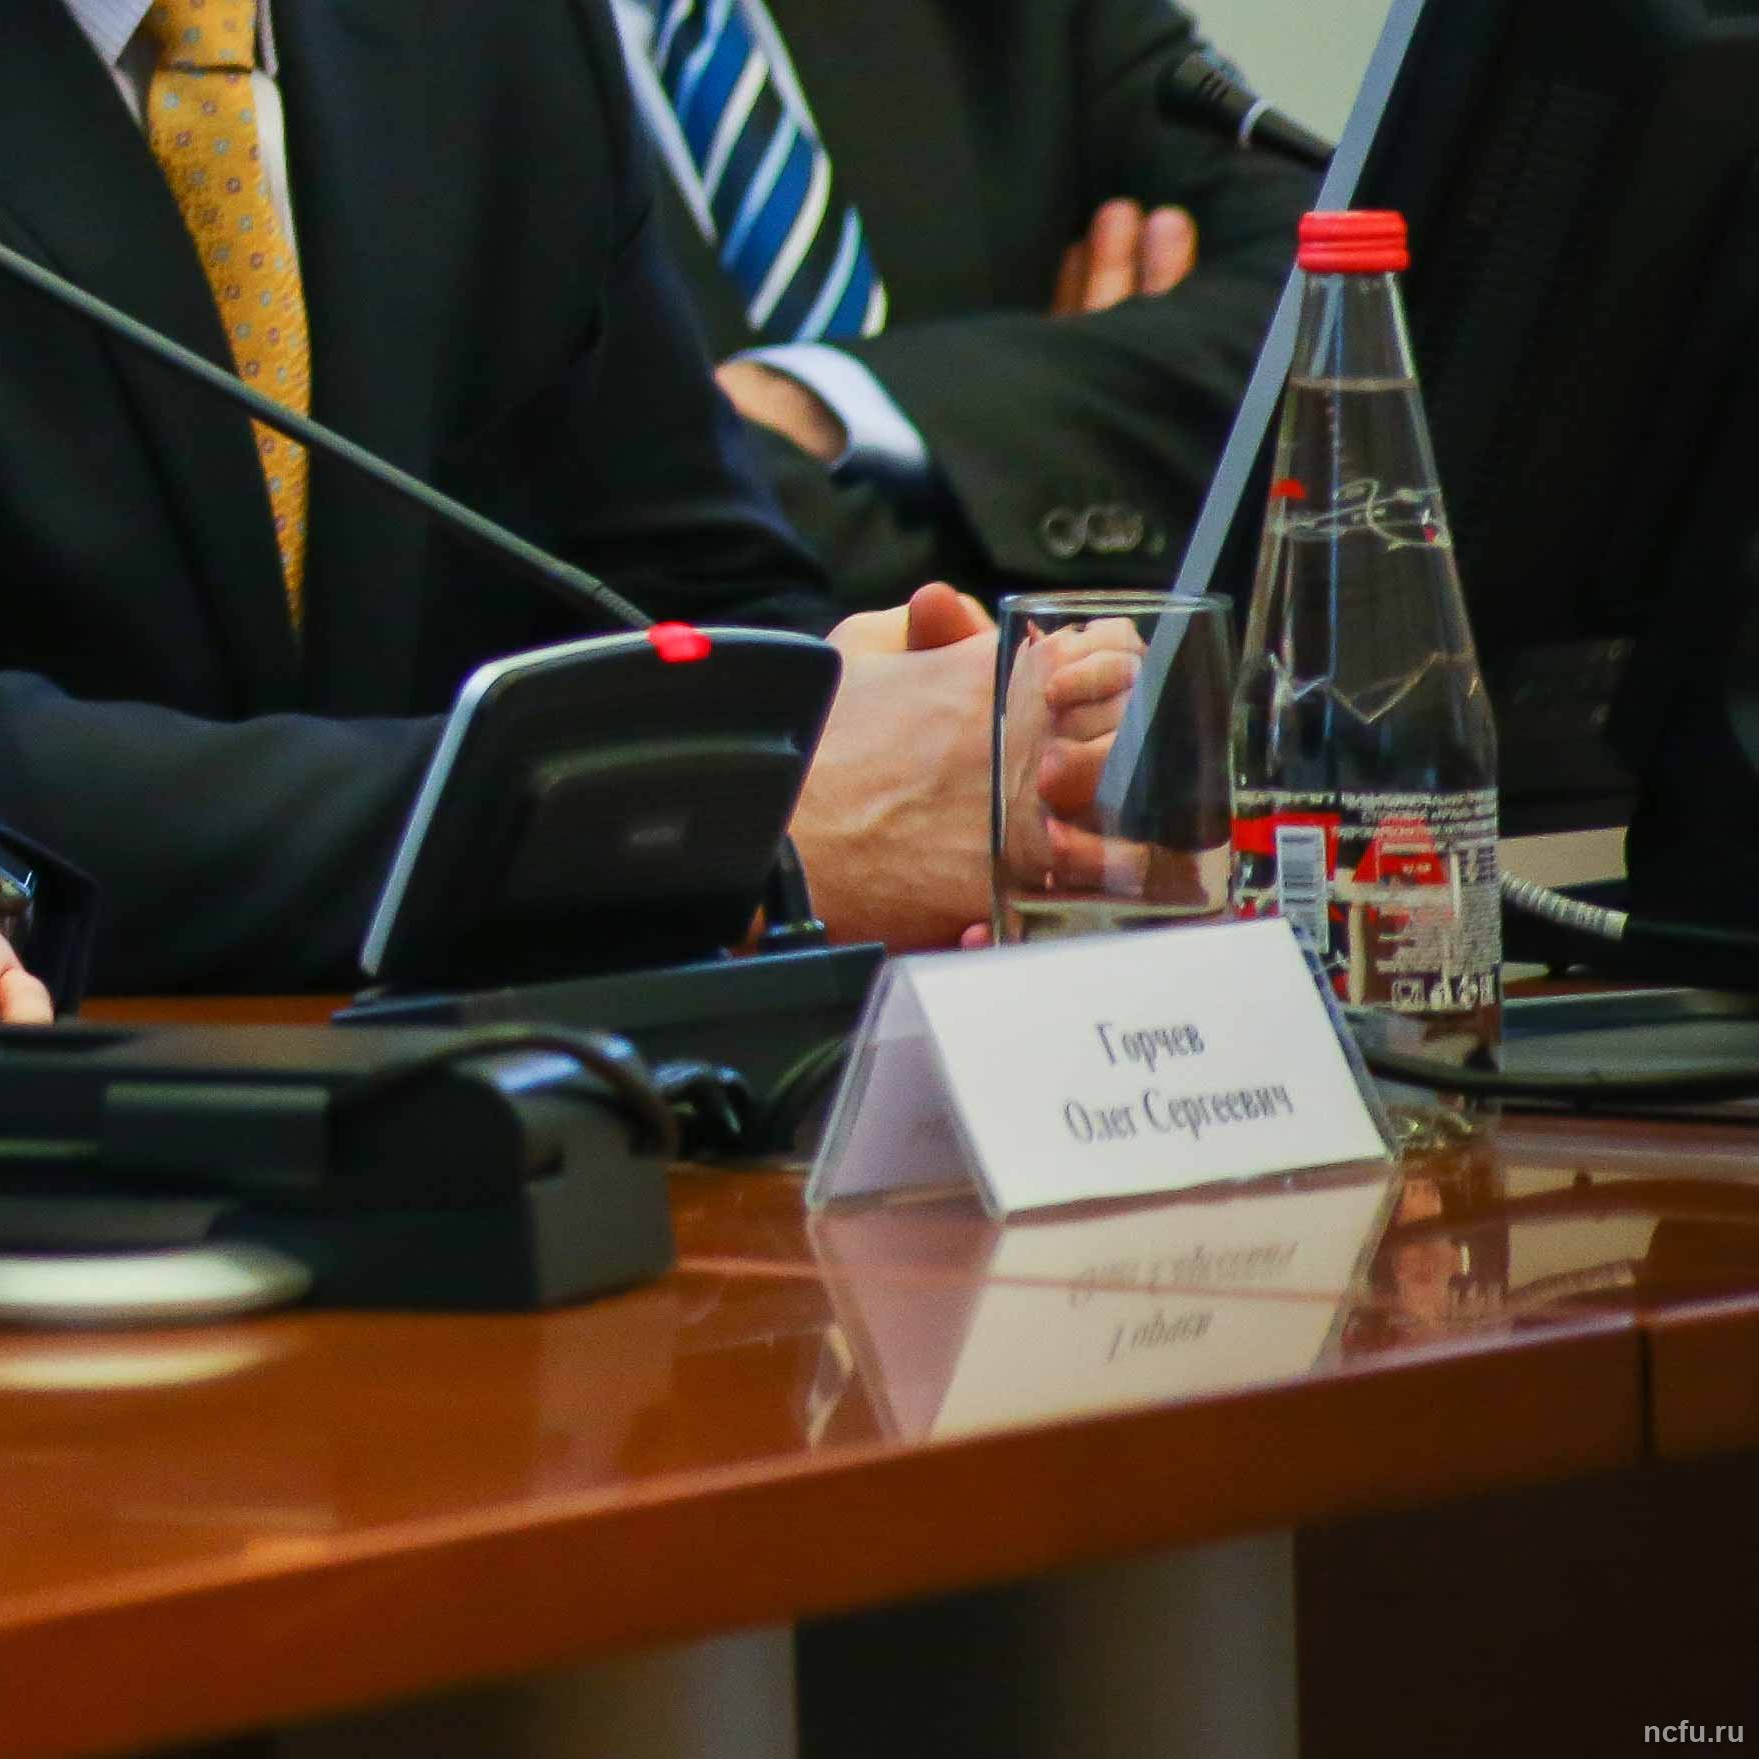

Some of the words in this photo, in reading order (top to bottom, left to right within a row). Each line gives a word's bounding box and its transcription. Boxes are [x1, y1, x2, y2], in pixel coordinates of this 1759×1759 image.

[1095, 1022, 1205, 1073] Горчев
[1063, 1100, 1137, 1144] Олег
[1142, 1085, 1294, 1141] Сергеевич
